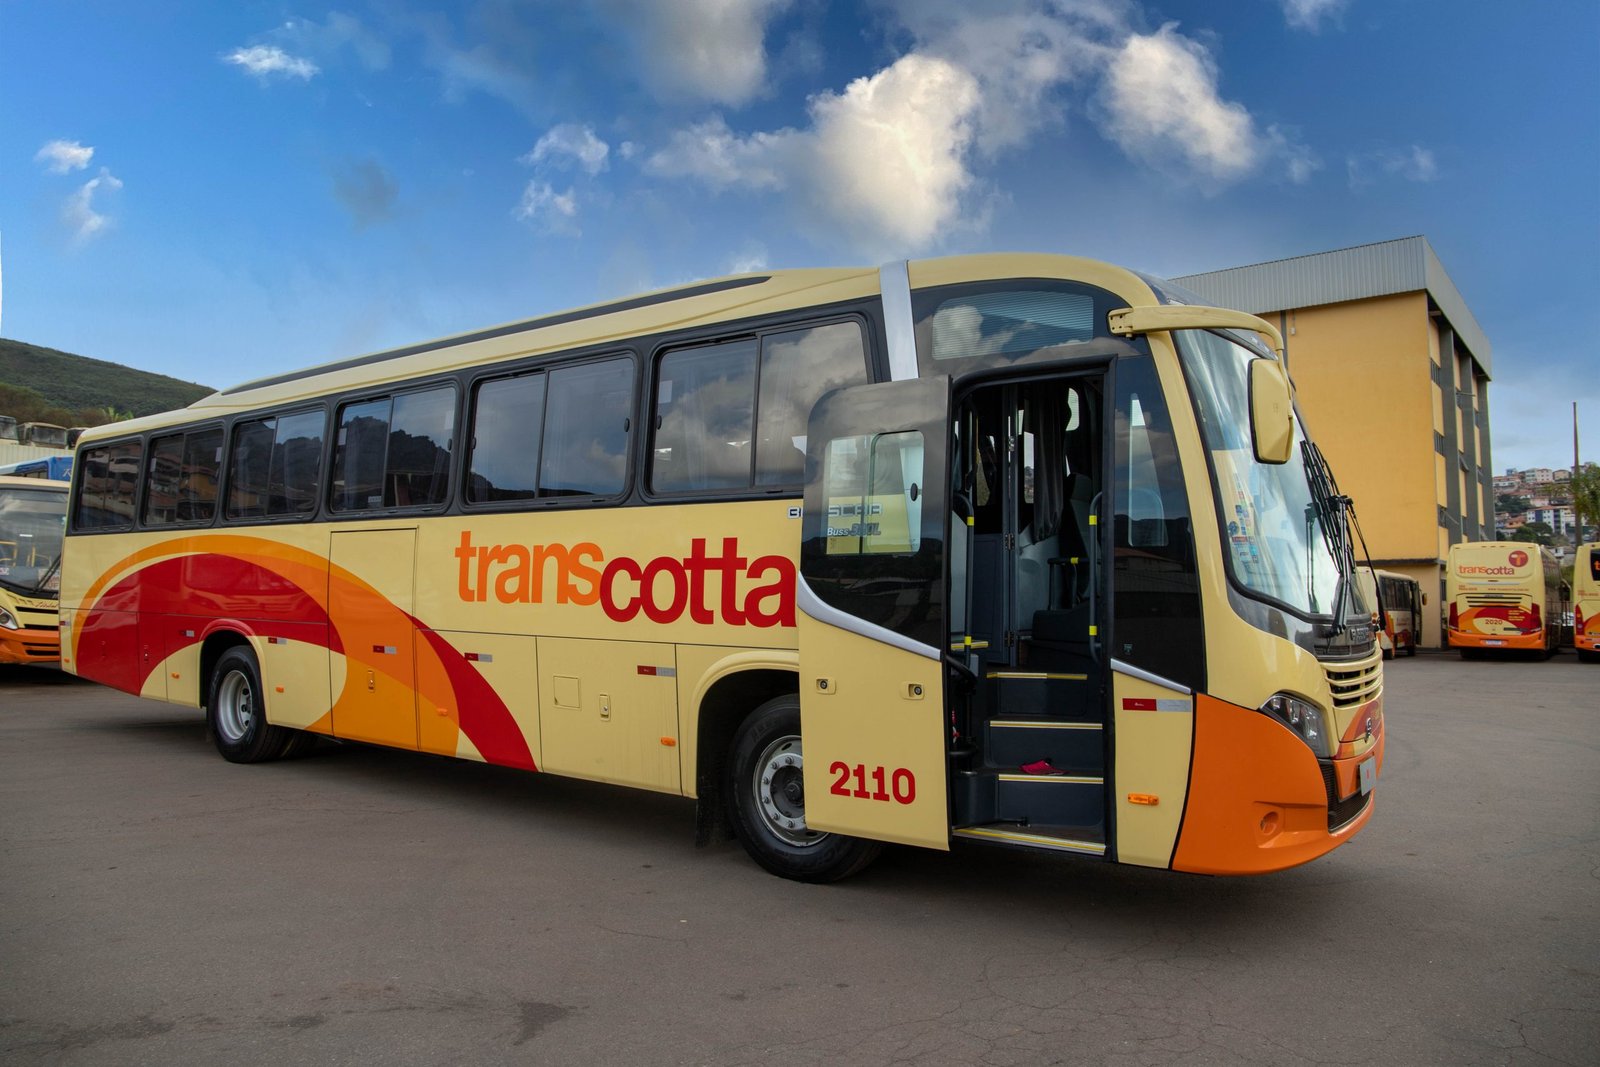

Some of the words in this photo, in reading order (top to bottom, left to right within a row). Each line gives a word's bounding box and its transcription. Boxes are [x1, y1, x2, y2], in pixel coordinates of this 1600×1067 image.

[787, 503, 883, 518] BSCAR
[827, 527, 849, 536] Buss
[1459, 565, 1515, 575] transcotta
[454, 530, 797, 628] transcotta
[829, 761, 916, 805] 2110
